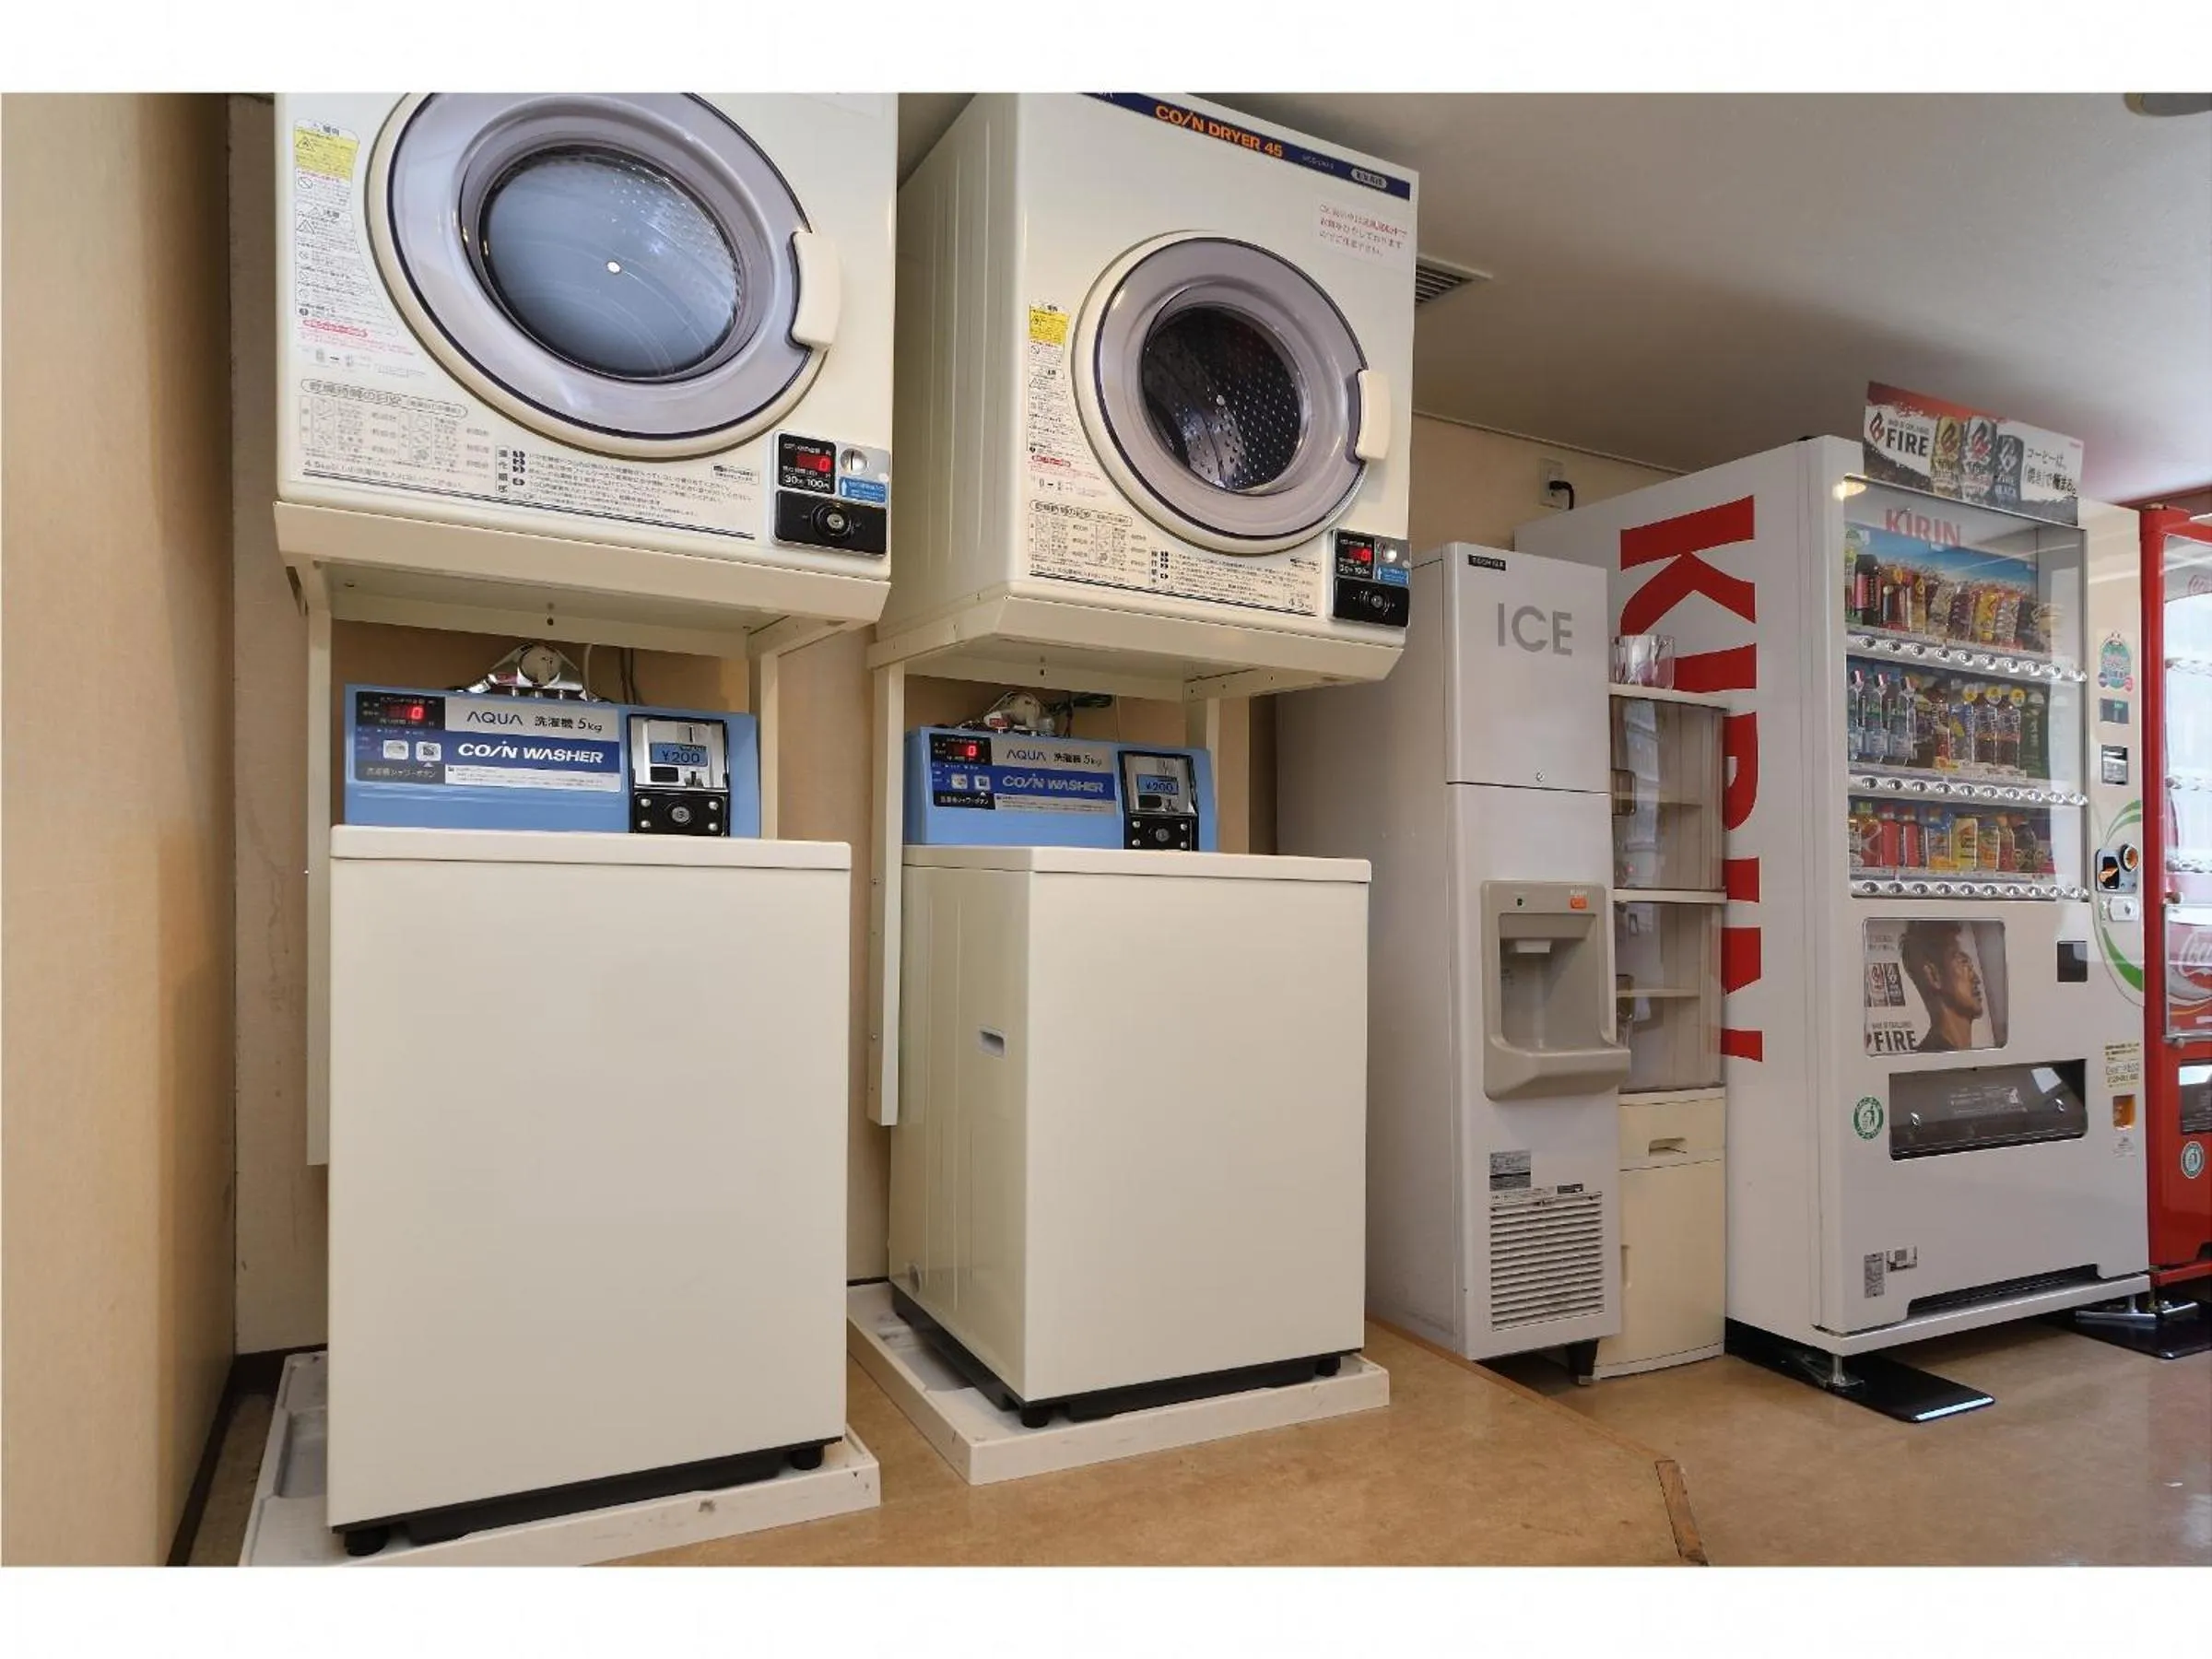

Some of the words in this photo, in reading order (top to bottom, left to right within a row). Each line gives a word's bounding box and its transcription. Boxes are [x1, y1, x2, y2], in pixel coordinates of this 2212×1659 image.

[1208, 121, 1262, 150] DRYER
[1264, 142, 1284, 159] 45
[1886, 427, 1931, 458] FIRE
[1884, 509, 1961, 547] KIRIN
[1498, 603, 1572, 656] ICE
[466, 711, 524, 726] AQUA
[578, 717, 603, 733] 5kg
[524, 747, 605, 764] WASHER
[663, 749, 700, 764] ¥200
[1006, 748, 1047, 761] AQUA
[1047, 779, 1105, 794] WASHER
[1873, 1030, 1918, 1052] FIRE
